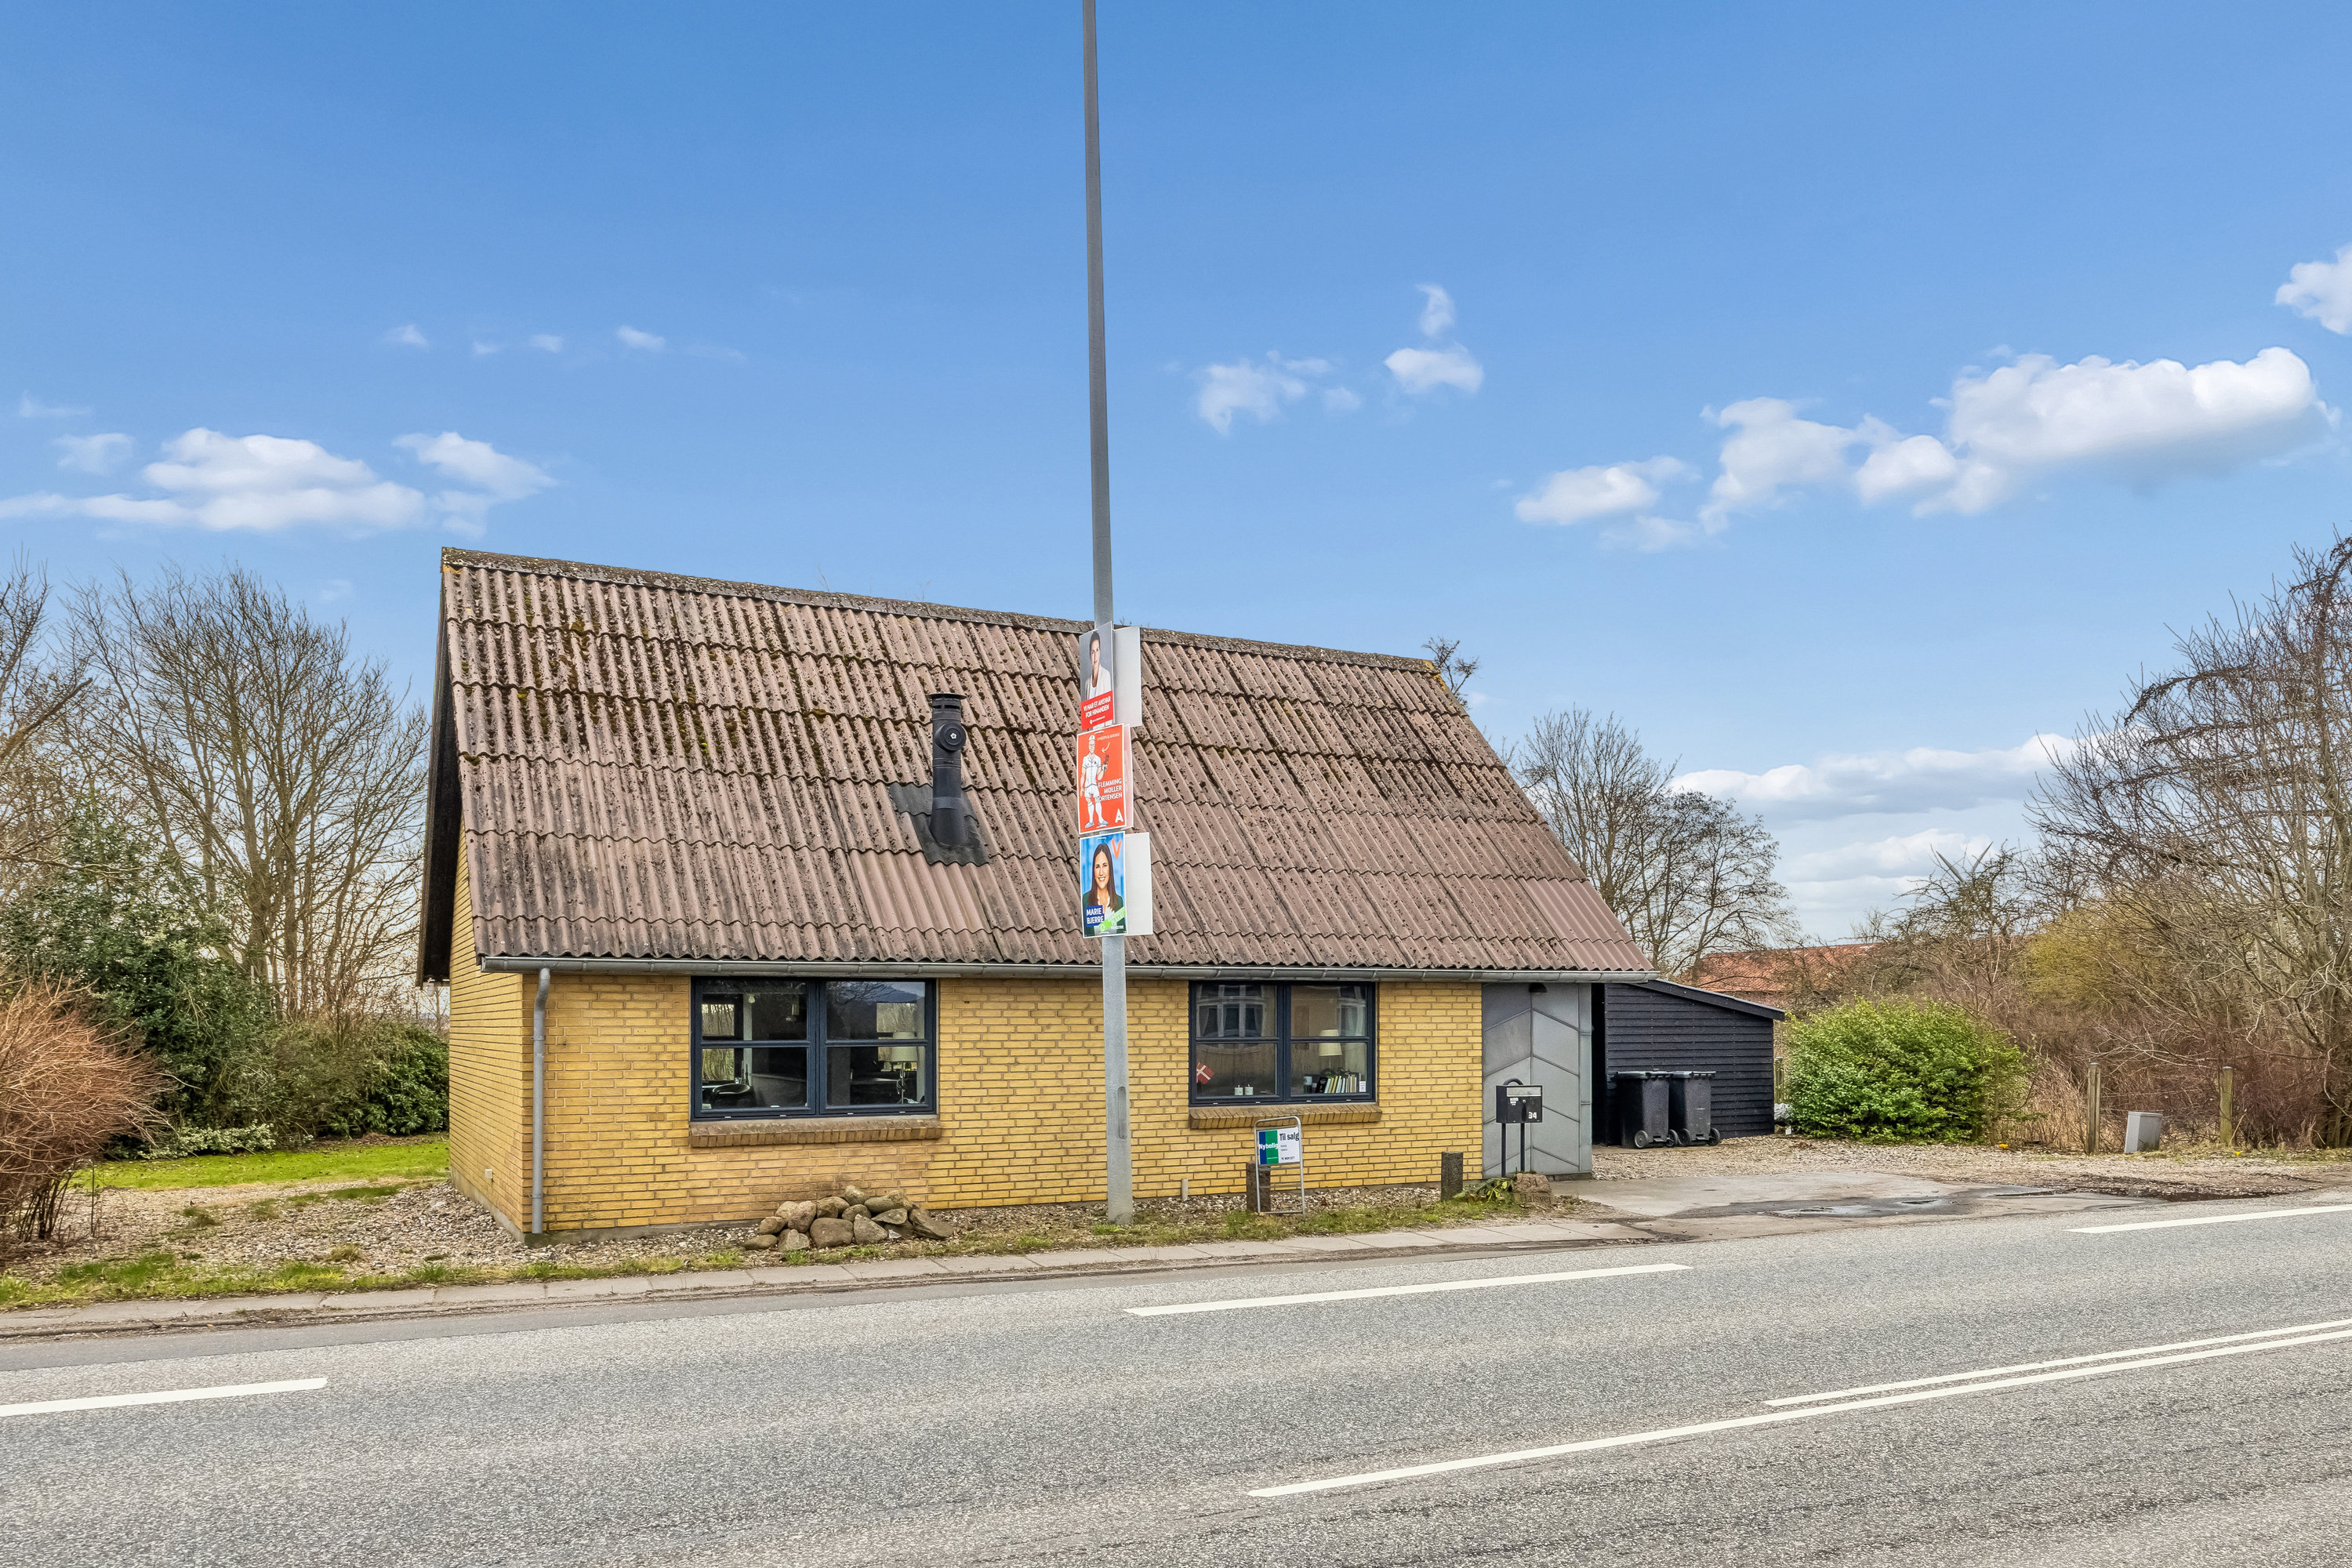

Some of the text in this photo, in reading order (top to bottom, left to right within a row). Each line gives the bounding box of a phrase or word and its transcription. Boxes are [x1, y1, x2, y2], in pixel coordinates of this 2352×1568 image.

[1098, 778, 1122, 788] FLEMMING
[1115, 808, 1124, 823] A
[1111, 838, 1122, 858] V
[1087, 916, 1104, 924] BJERRE
[1287, 1132, 1299, 1142] salg
[1526, 1178, 1539, 1188] 34
